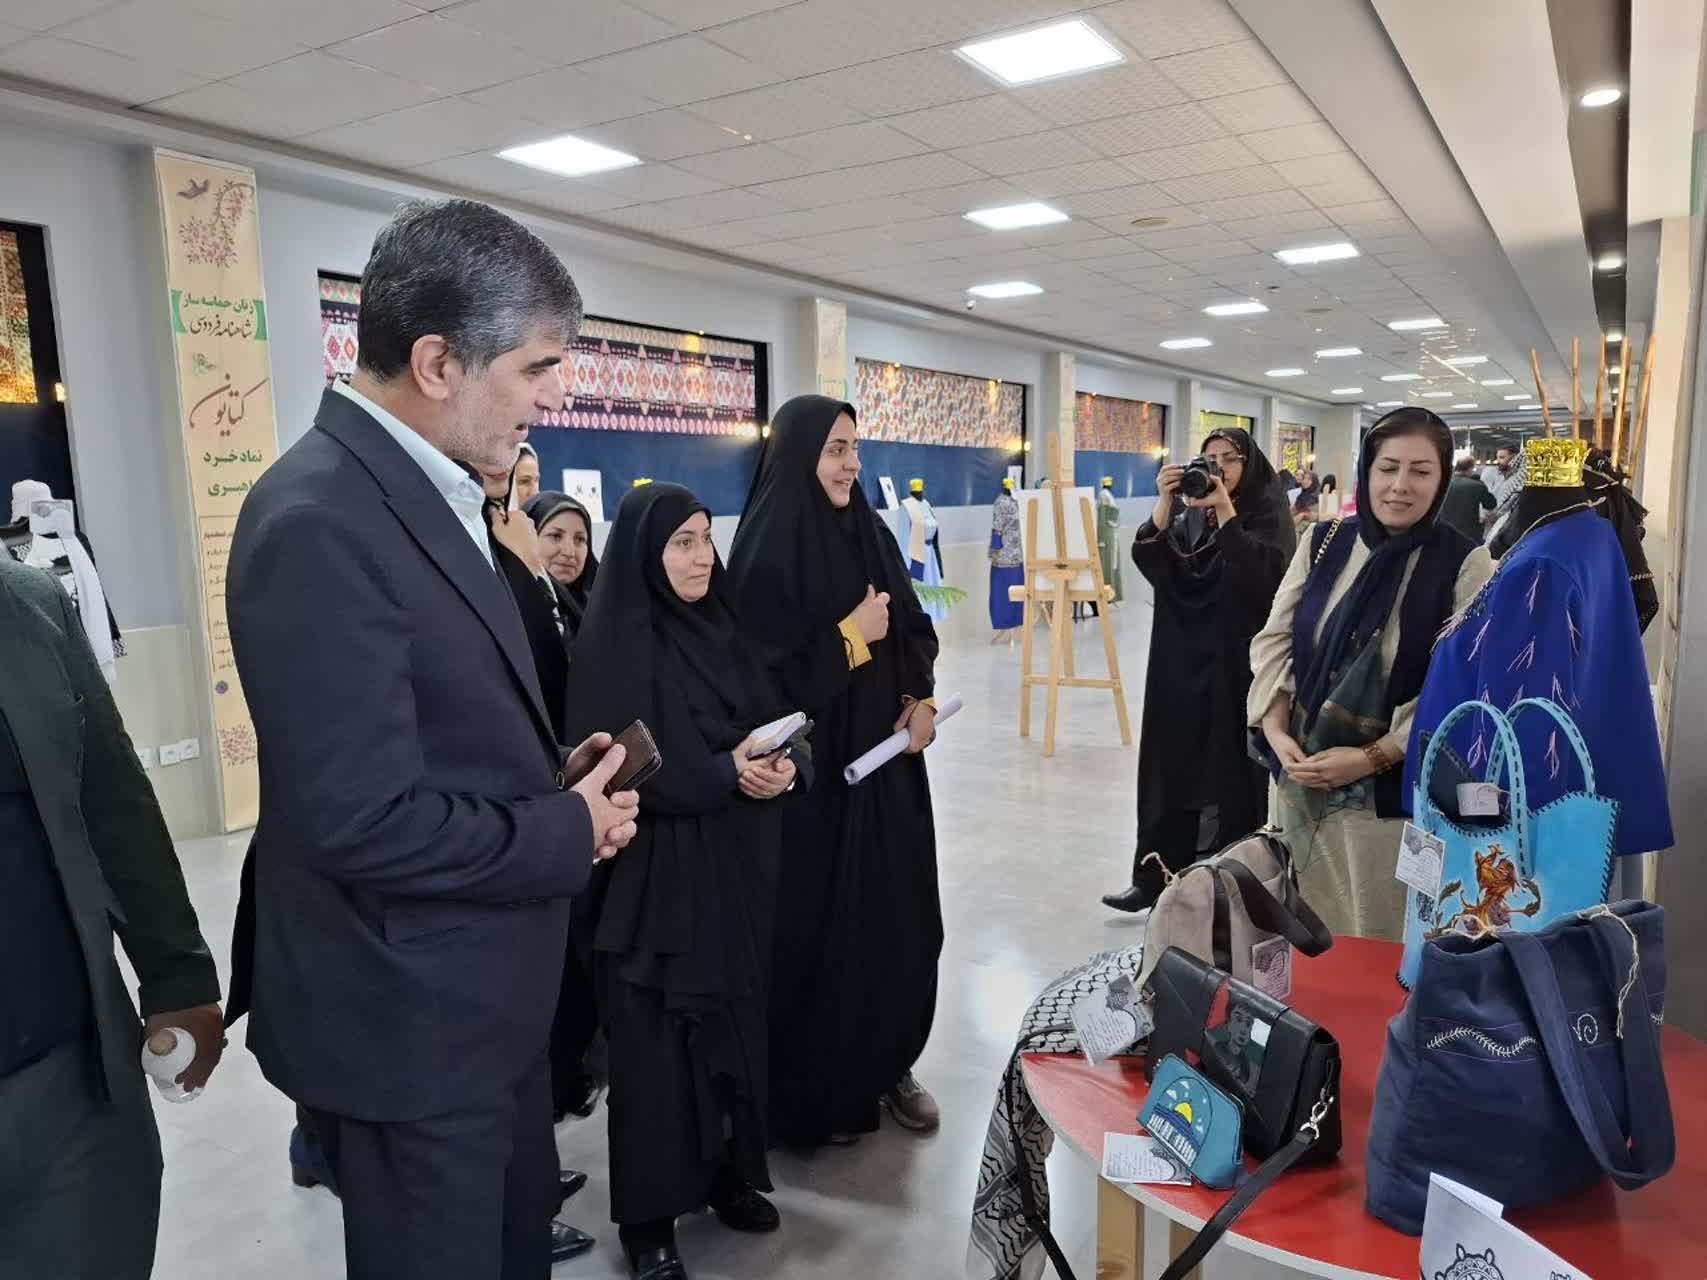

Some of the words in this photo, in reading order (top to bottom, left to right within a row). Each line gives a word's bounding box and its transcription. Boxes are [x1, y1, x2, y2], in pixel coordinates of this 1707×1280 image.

[183, 292, 200, 308] ساز
[201, 295, 232, 308] حماسه
[233, 298, 254, 314] زنان
[190, 313, 221, 337] فردوسی
[214, 318, 252, 339] شاهنامه
[189, 373, 270, 437] کتایون
[203, 449, 238, 467] خرد
[239, 449, 263, 463] نماد
